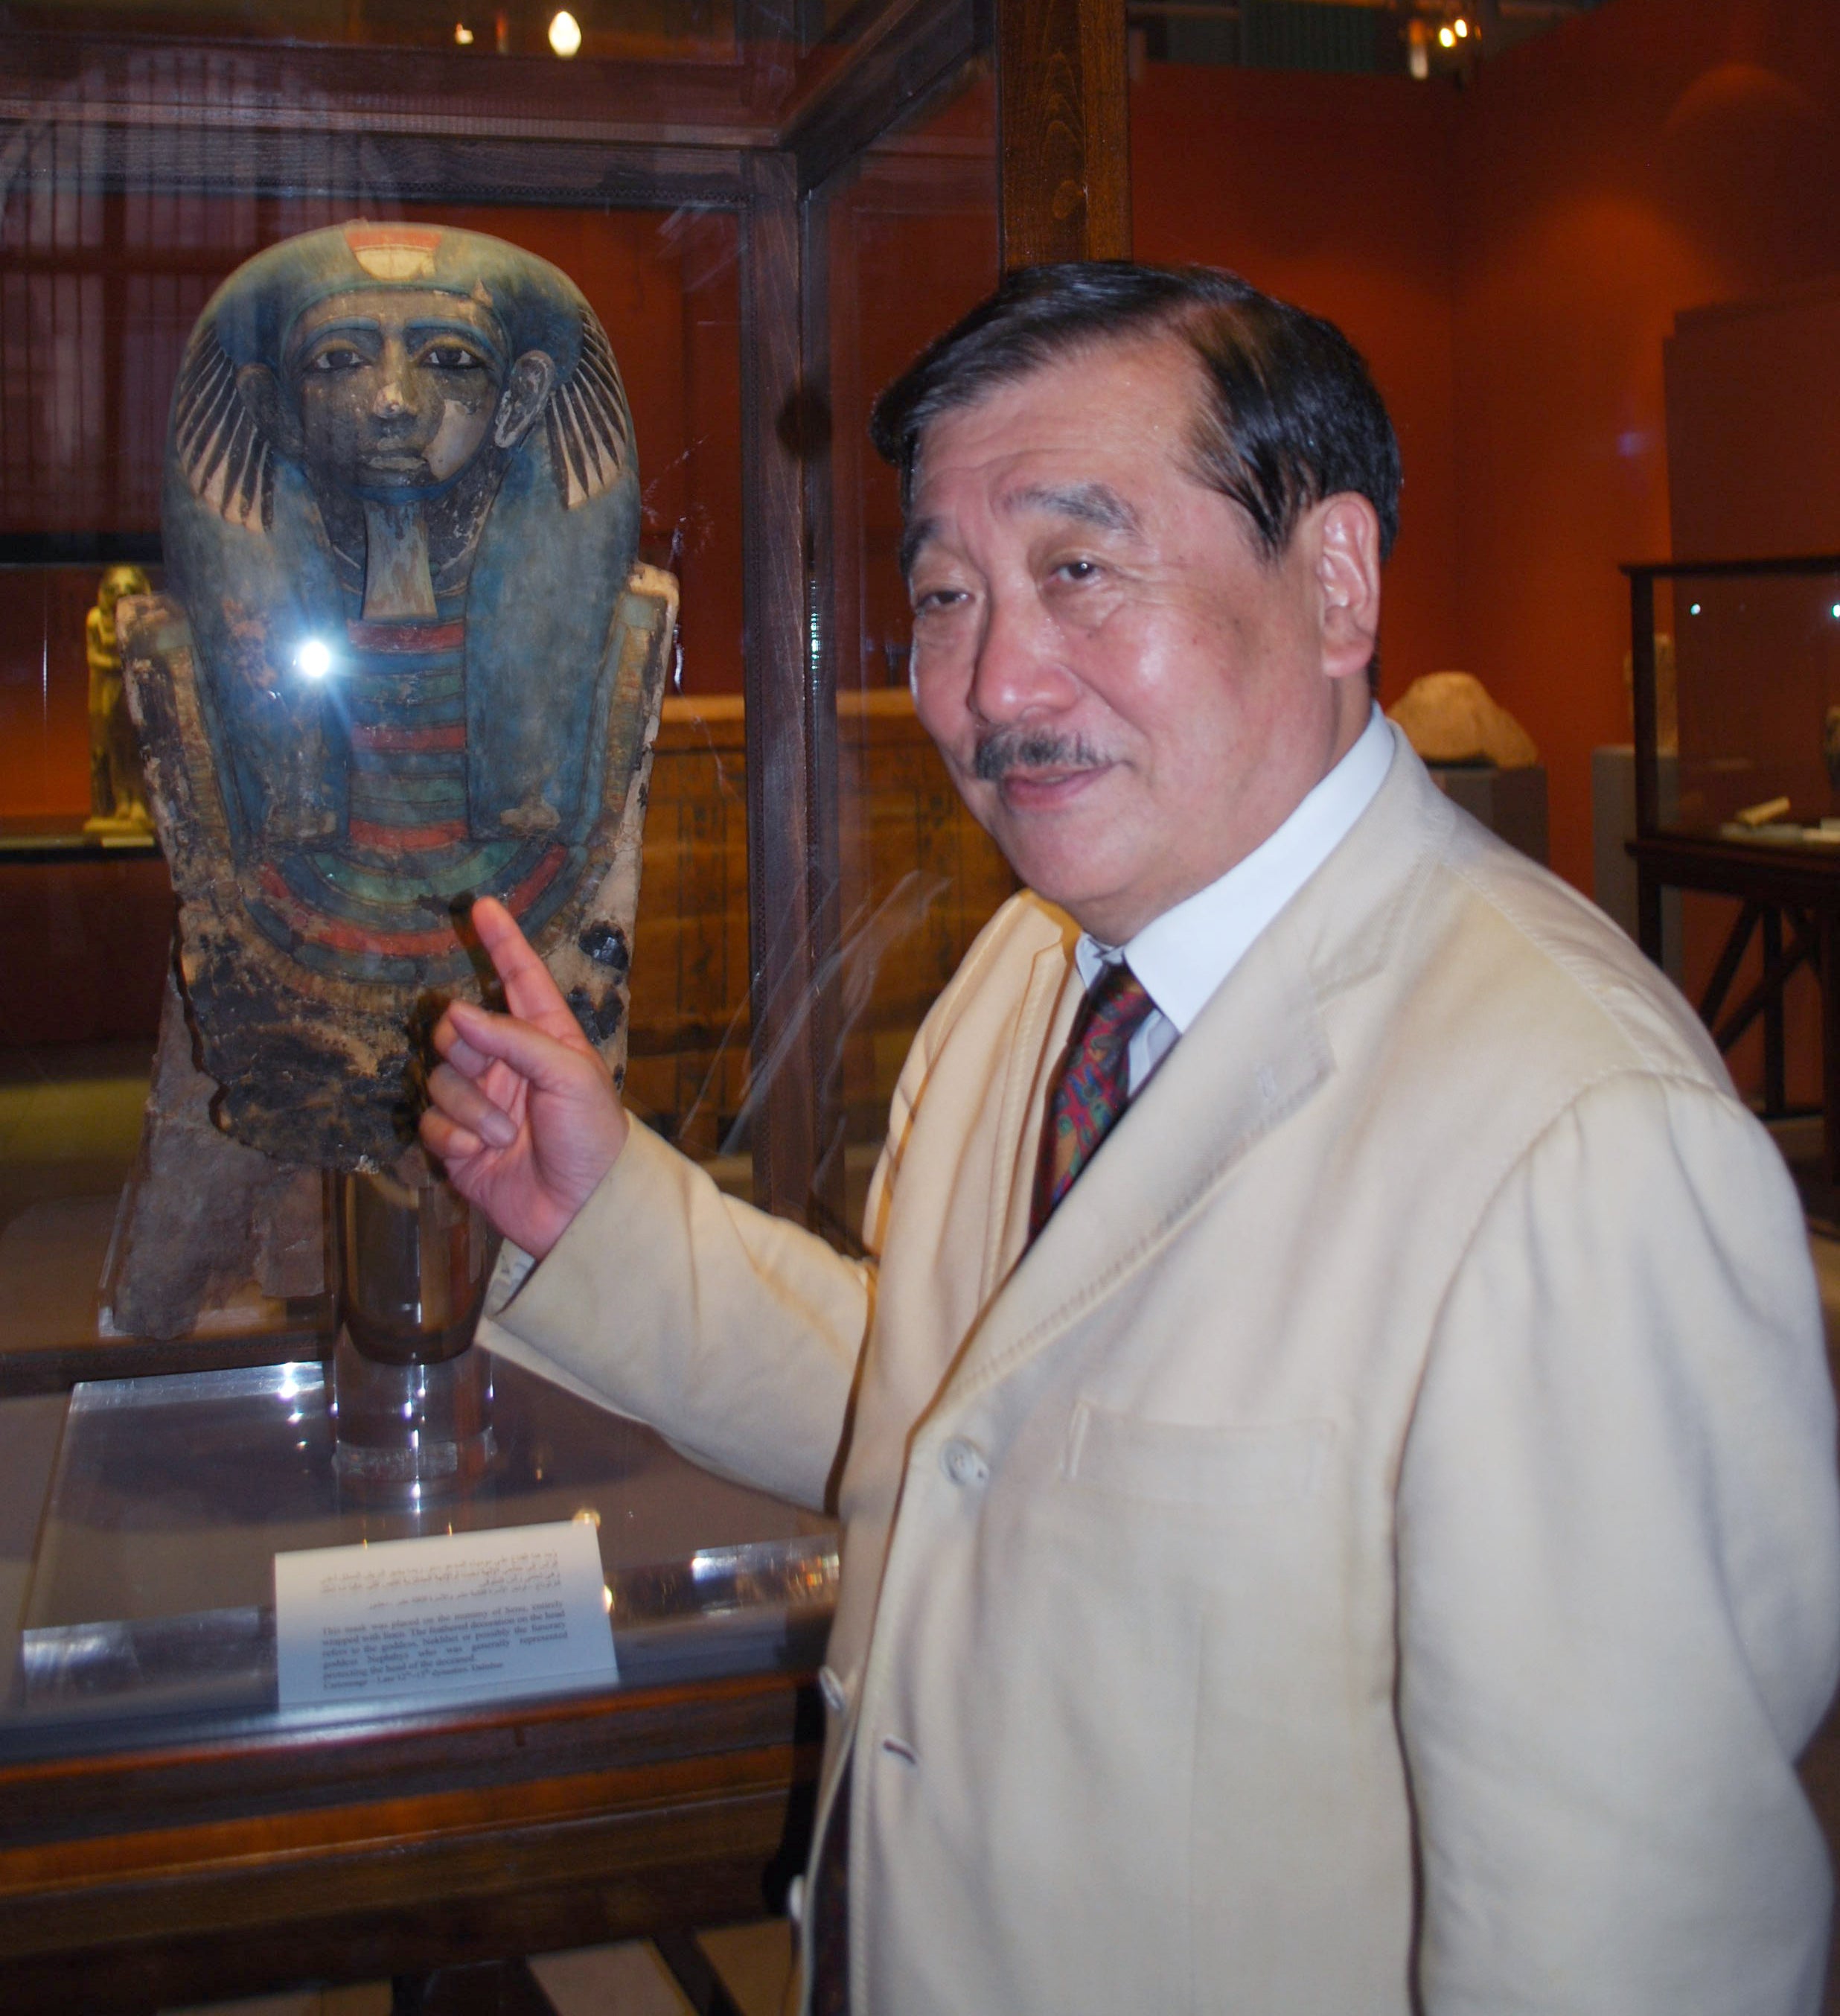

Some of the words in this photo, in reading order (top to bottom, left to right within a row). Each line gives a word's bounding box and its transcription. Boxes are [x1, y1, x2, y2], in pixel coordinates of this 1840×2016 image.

[322, 1634, 360, 1647] wrapped
[362, 1632, 380, 1641] with
[429, 1622, 468, 1634] feathered
[470, 1617, 514, 1629] decoration
[530, 1613, 543, 1621] the
[545, 1609, 565, 1619] head
[345, 1624, 365, 1633] mask
[392, 1617, 419, 1630] placed
[438, 1613, 450, 1623] the
[454, 1611, 488, 1622] mummy
[492, 1607, 502, 1615] of
[322, 1647, 348, 1657] refers
[364, 1645, 377, 1653] the
[476, 1628, 510, 1641] possibly
[514, 1626, 528, 1634] the
[418, 1648, 438, 1657] who
[472, 1639, 510, 1652] generally
[520, 1630, 568, 1645] represented
